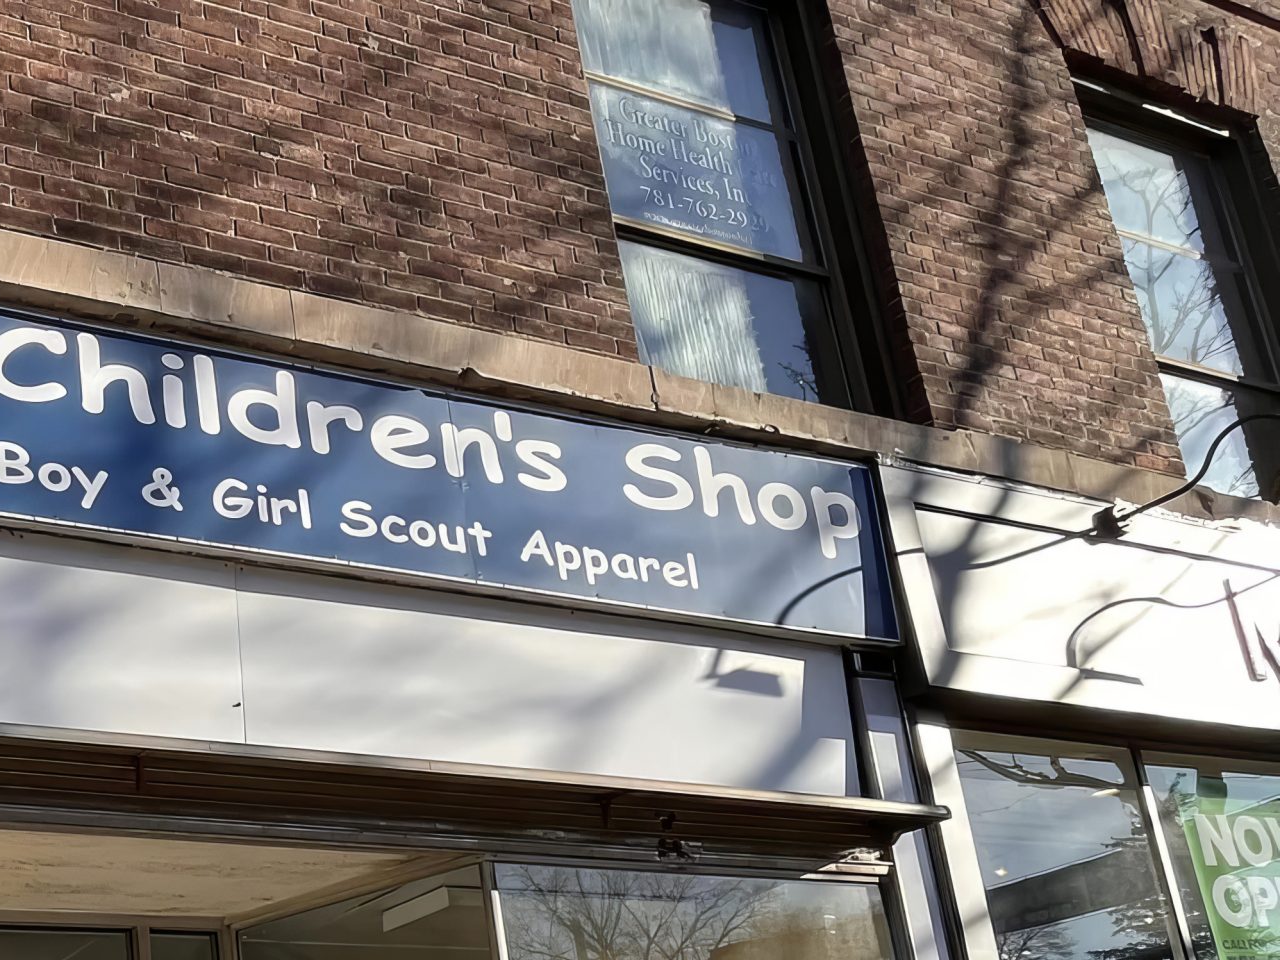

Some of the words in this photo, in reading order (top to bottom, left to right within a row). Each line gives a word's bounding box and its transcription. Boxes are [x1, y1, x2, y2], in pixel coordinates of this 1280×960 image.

[620, 97, 688, 138] Greater
[603, 117, 666, 157] Home
[670, 137, 733, 176] Health
[639, 154, 721, 200] Services,
[139, 466, 183, 513] &
[211, 478, 312, 532] Girl
[338, 499, 493, 558] Scout
[518, 527, 700, 592] Apparel
[622, 442, 862, 560] Shop
[1212, 875, 1280, 929] OP
